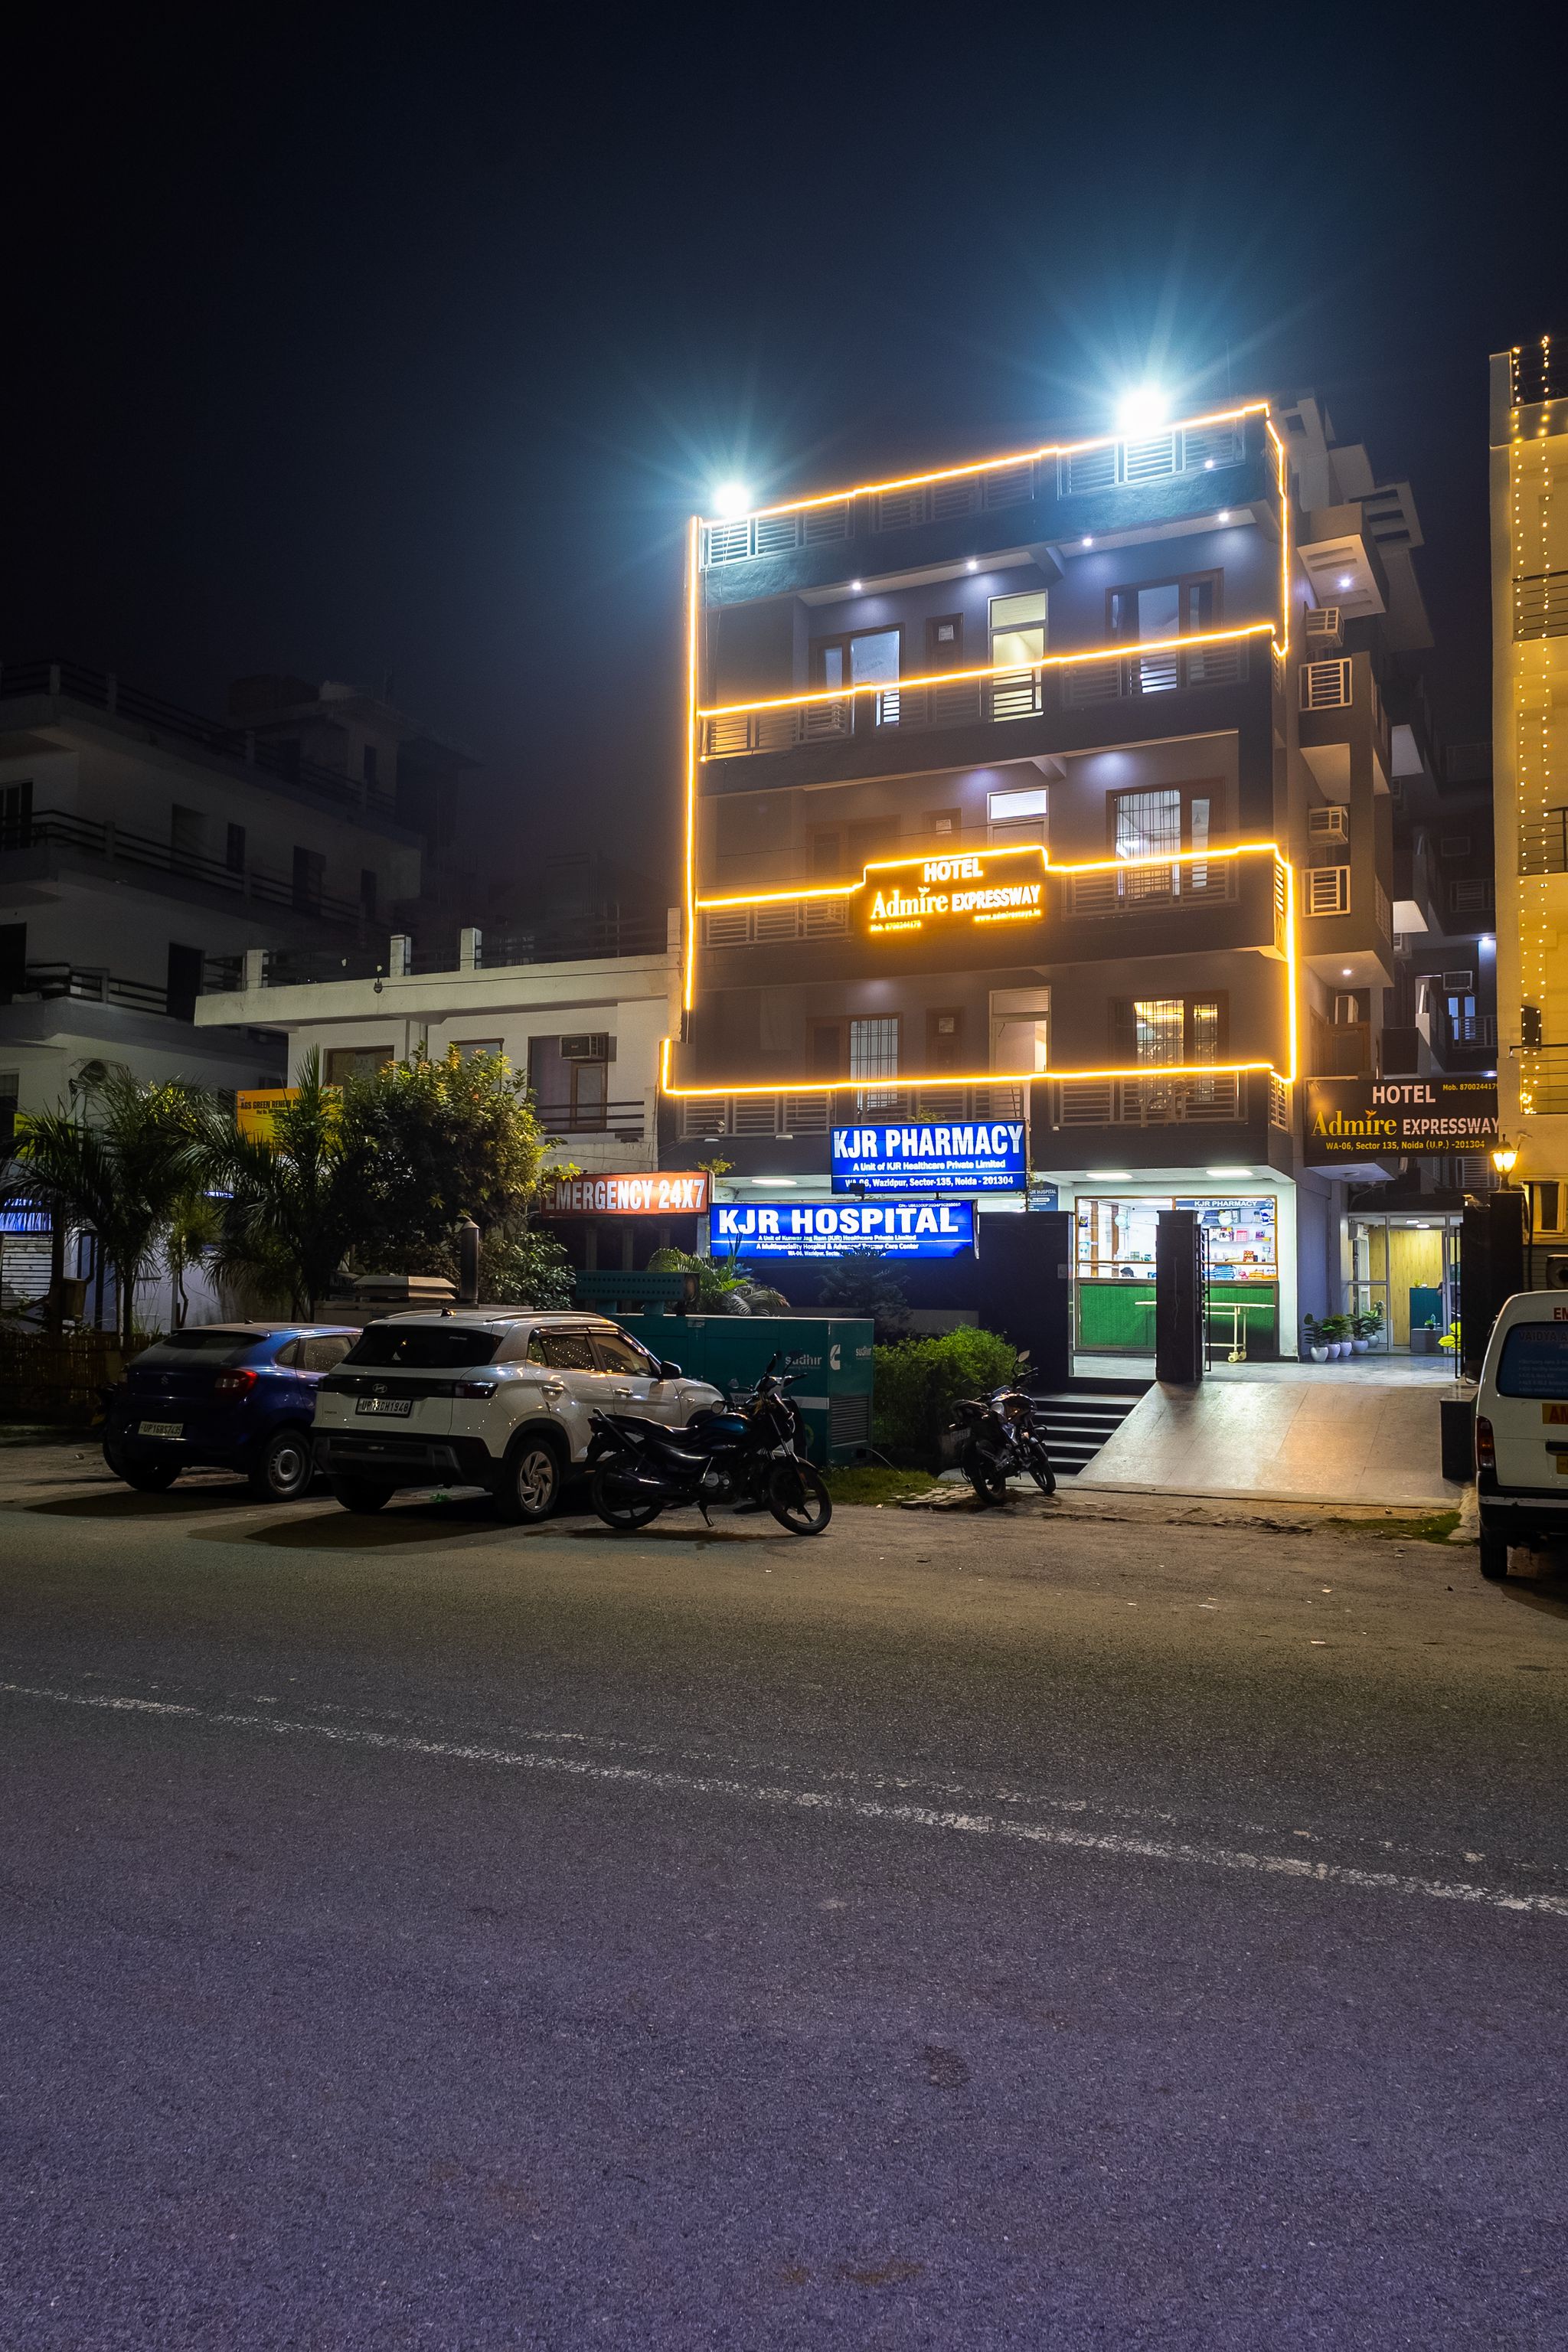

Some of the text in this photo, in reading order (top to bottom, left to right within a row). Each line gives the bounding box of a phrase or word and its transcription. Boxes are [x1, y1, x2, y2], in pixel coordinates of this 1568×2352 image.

[923, 858, 984, 883] HOTEL
[871, 884, 1041, 920] Admire EXPRESSWAY
[1373, 1085, 1436, 1104] HOTEL
[253, 1101, 270, 1109] GREEN
[1310, 1109, 1498, 1137] Admire EXPRESSWAY
[833, 1125, 1024, 1158] KJR PHARMACY
[1326, 1142, 1353, 1152] WA-06,
[1355, 1142, 1380, 1150] Sector
[1383, 1141, 1400, 1152] 135,
[1401, 1141, 1423, 1149] Noida
[1426, 1139, 1449, 1151] (U.P.)
[852, 1159, 1006, 1171] A Unit of KJR Healthcare Private Limited
[872, 1178, 910, 1190] Wazidpur,
[910, 1177, 954, 1187] Sector-135,
[955, 1176, 978, 1186] Noida
[983, 1175, 1014, 1186] 201304
[546, 1178, 706, 1210] EMERGENCY 24X7
[718, 1207, 959, 1235] KJR HOSPITAL
[1519, 1331, 1557, 1342] VAIDYA
[785, 1354, 823, 1366] sudhir
